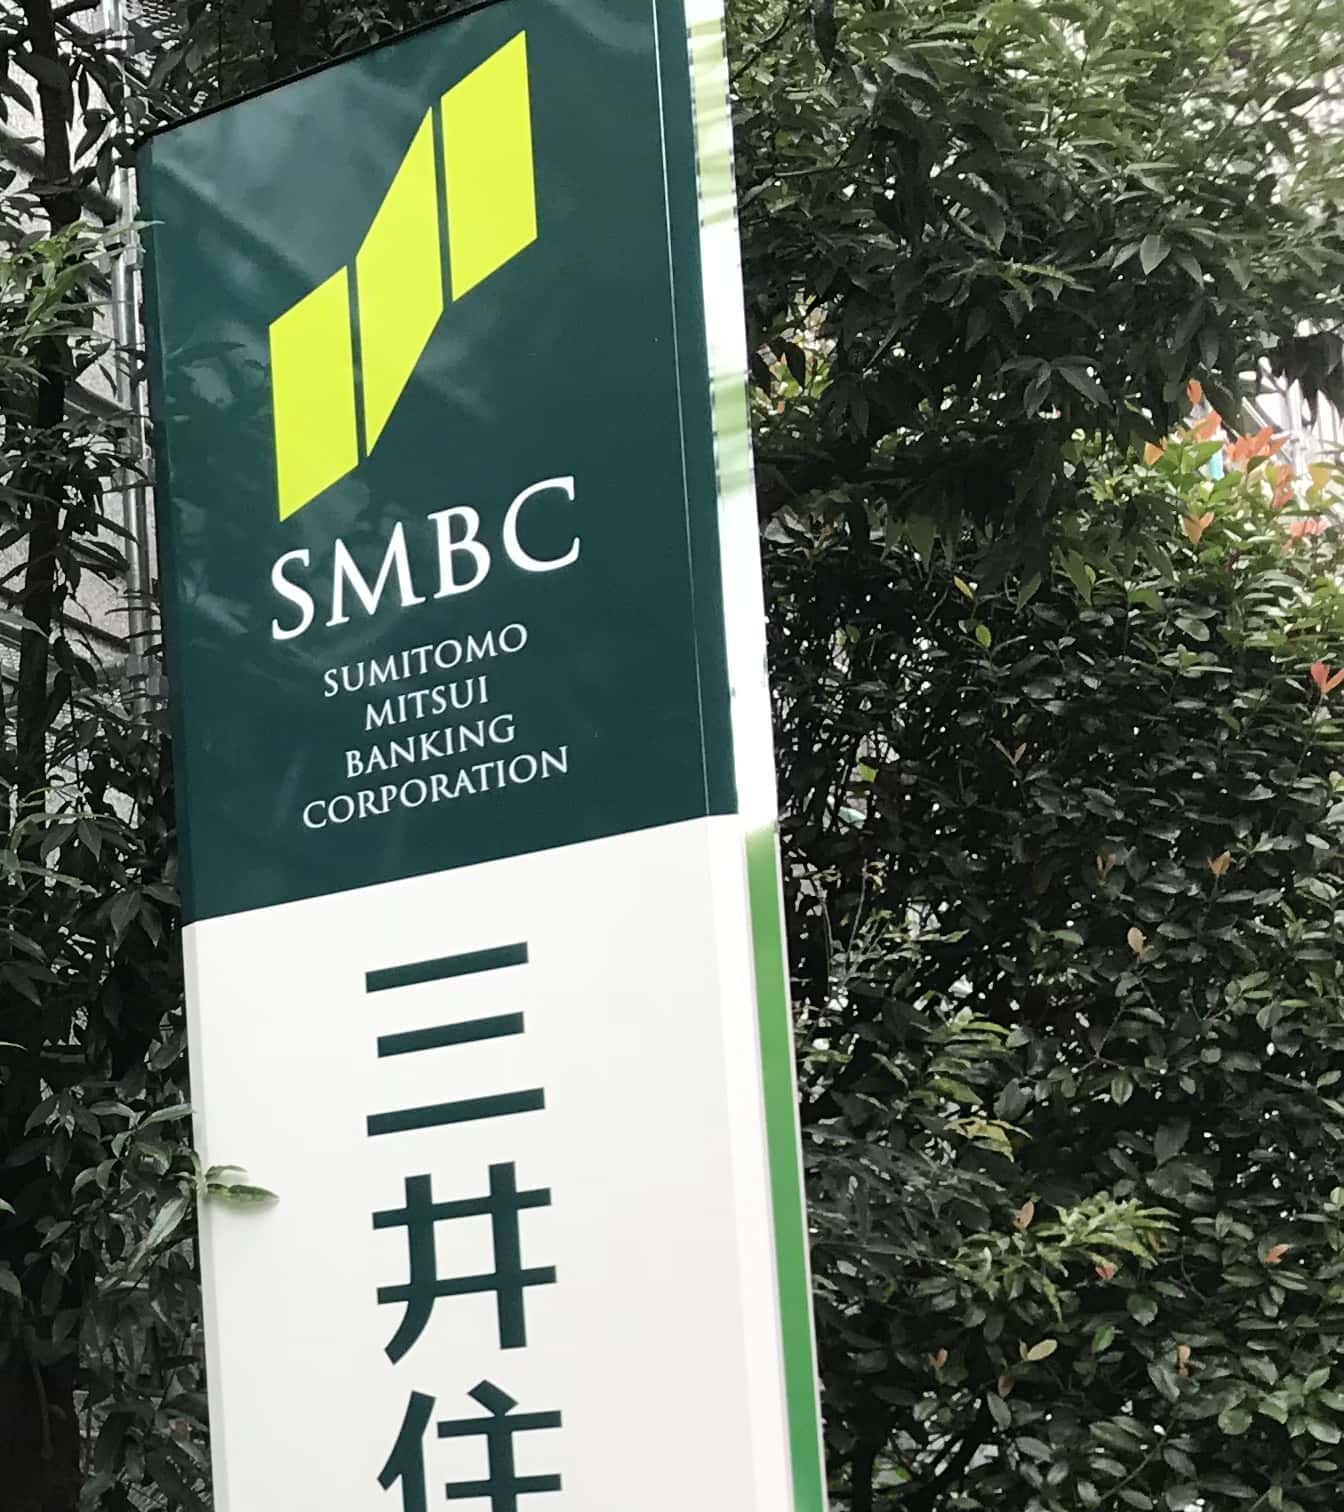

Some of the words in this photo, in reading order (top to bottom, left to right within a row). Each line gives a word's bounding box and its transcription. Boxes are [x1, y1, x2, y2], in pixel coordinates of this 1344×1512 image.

[270, 475, 580, 641] SMBC
[323, 623, 528, 698] SUMITOMO
[364, 675, 489, 731] MITSUI
[345, 714, 517, 779] BANKING
[302, 746, 570, 829] CORPORATION
